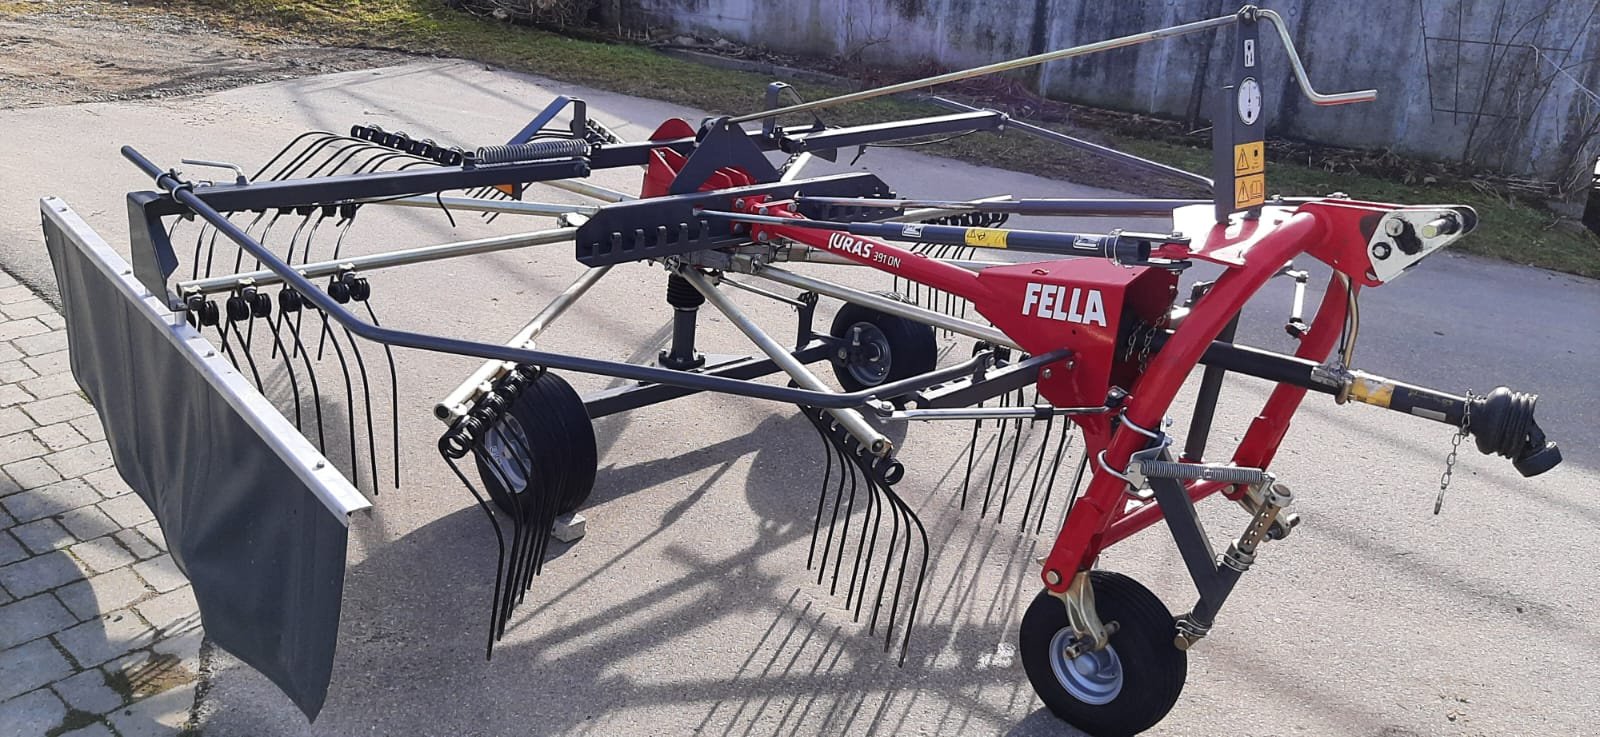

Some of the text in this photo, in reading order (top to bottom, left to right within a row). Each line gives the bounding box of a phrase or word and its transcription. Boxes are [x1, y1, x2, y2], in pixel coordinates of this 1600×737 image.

[828, 232, 874, 258] JURAS
[873, 251, 887, 264] 391
[1022, 282, 1107, 328] FELLA
